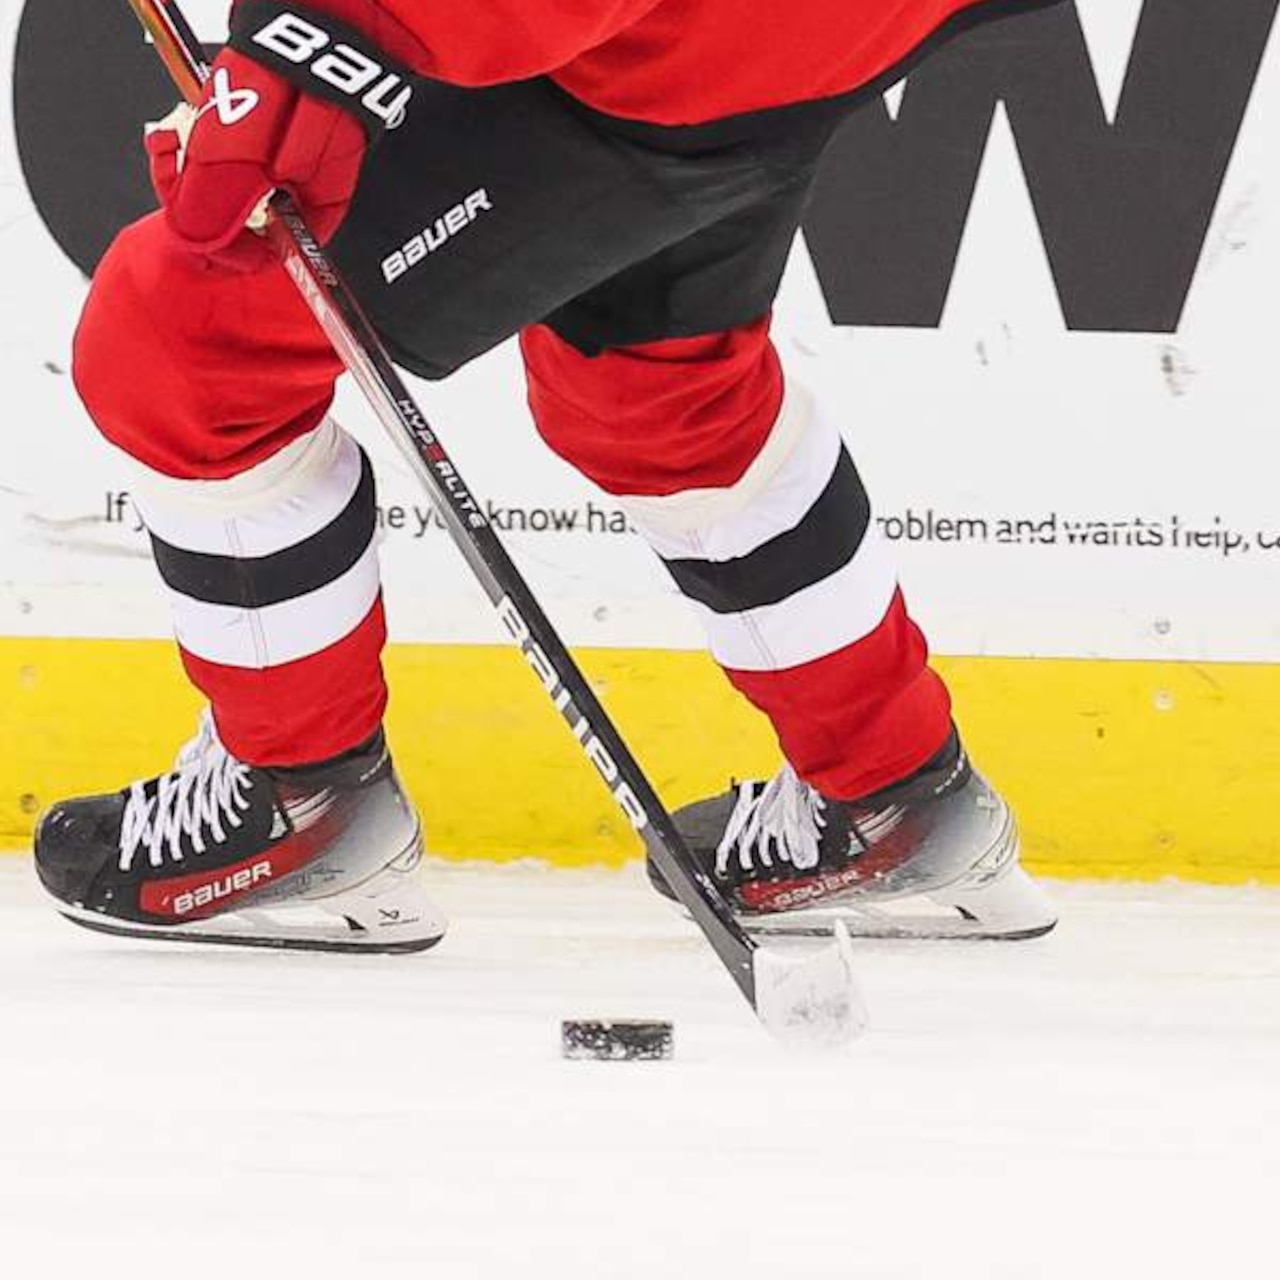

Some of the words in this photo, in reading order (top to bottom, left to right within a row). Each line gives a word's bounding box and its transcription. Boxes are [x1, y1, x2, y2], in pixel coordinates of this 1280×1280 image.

[252, 11, 412, 130] BAU
[381, 187, 494, 285] BAUER
[105, 491, 130, 524] If
[487, 500, 579, 532] know
[586, 501, 638, 535] ha
[996, 512, 1056, 544] and
[174, 860, 272, 915] BAUER
